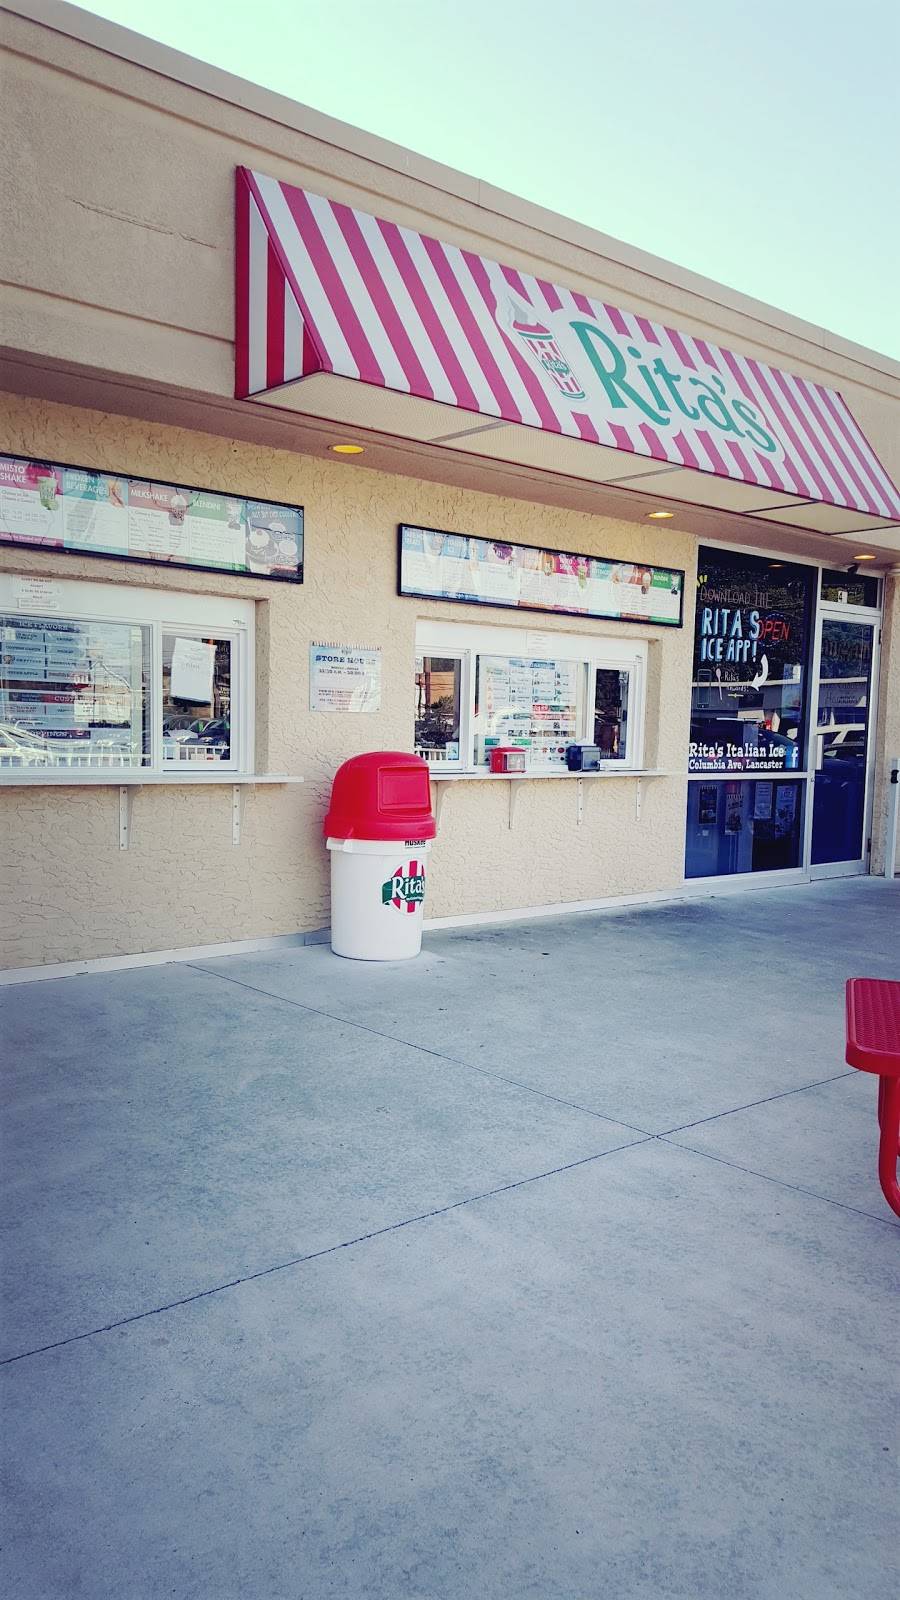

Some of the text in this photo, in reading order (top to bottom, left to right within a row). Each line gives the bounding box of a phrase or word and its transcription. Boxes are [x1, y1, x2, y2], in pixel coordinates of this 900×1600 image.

[568, 320, 777, 453] Rita's
[0, 463, 25, 474] MISTO
[0, 472, 26, 483] SHAKE
[131, 489, 169, 502] MILKSHAKE
[700, 585, 751, 605] DOWNLOAD
[757, 619, 791, 640] OPEN
[701, 638, 758, 663] ICE APP!
[315, 655, 345, 663] STORE
[688, 742, 785, 758] Rita's Italian Ice
[688, 759, 784, 771] Columbia Ave, Lancaster
